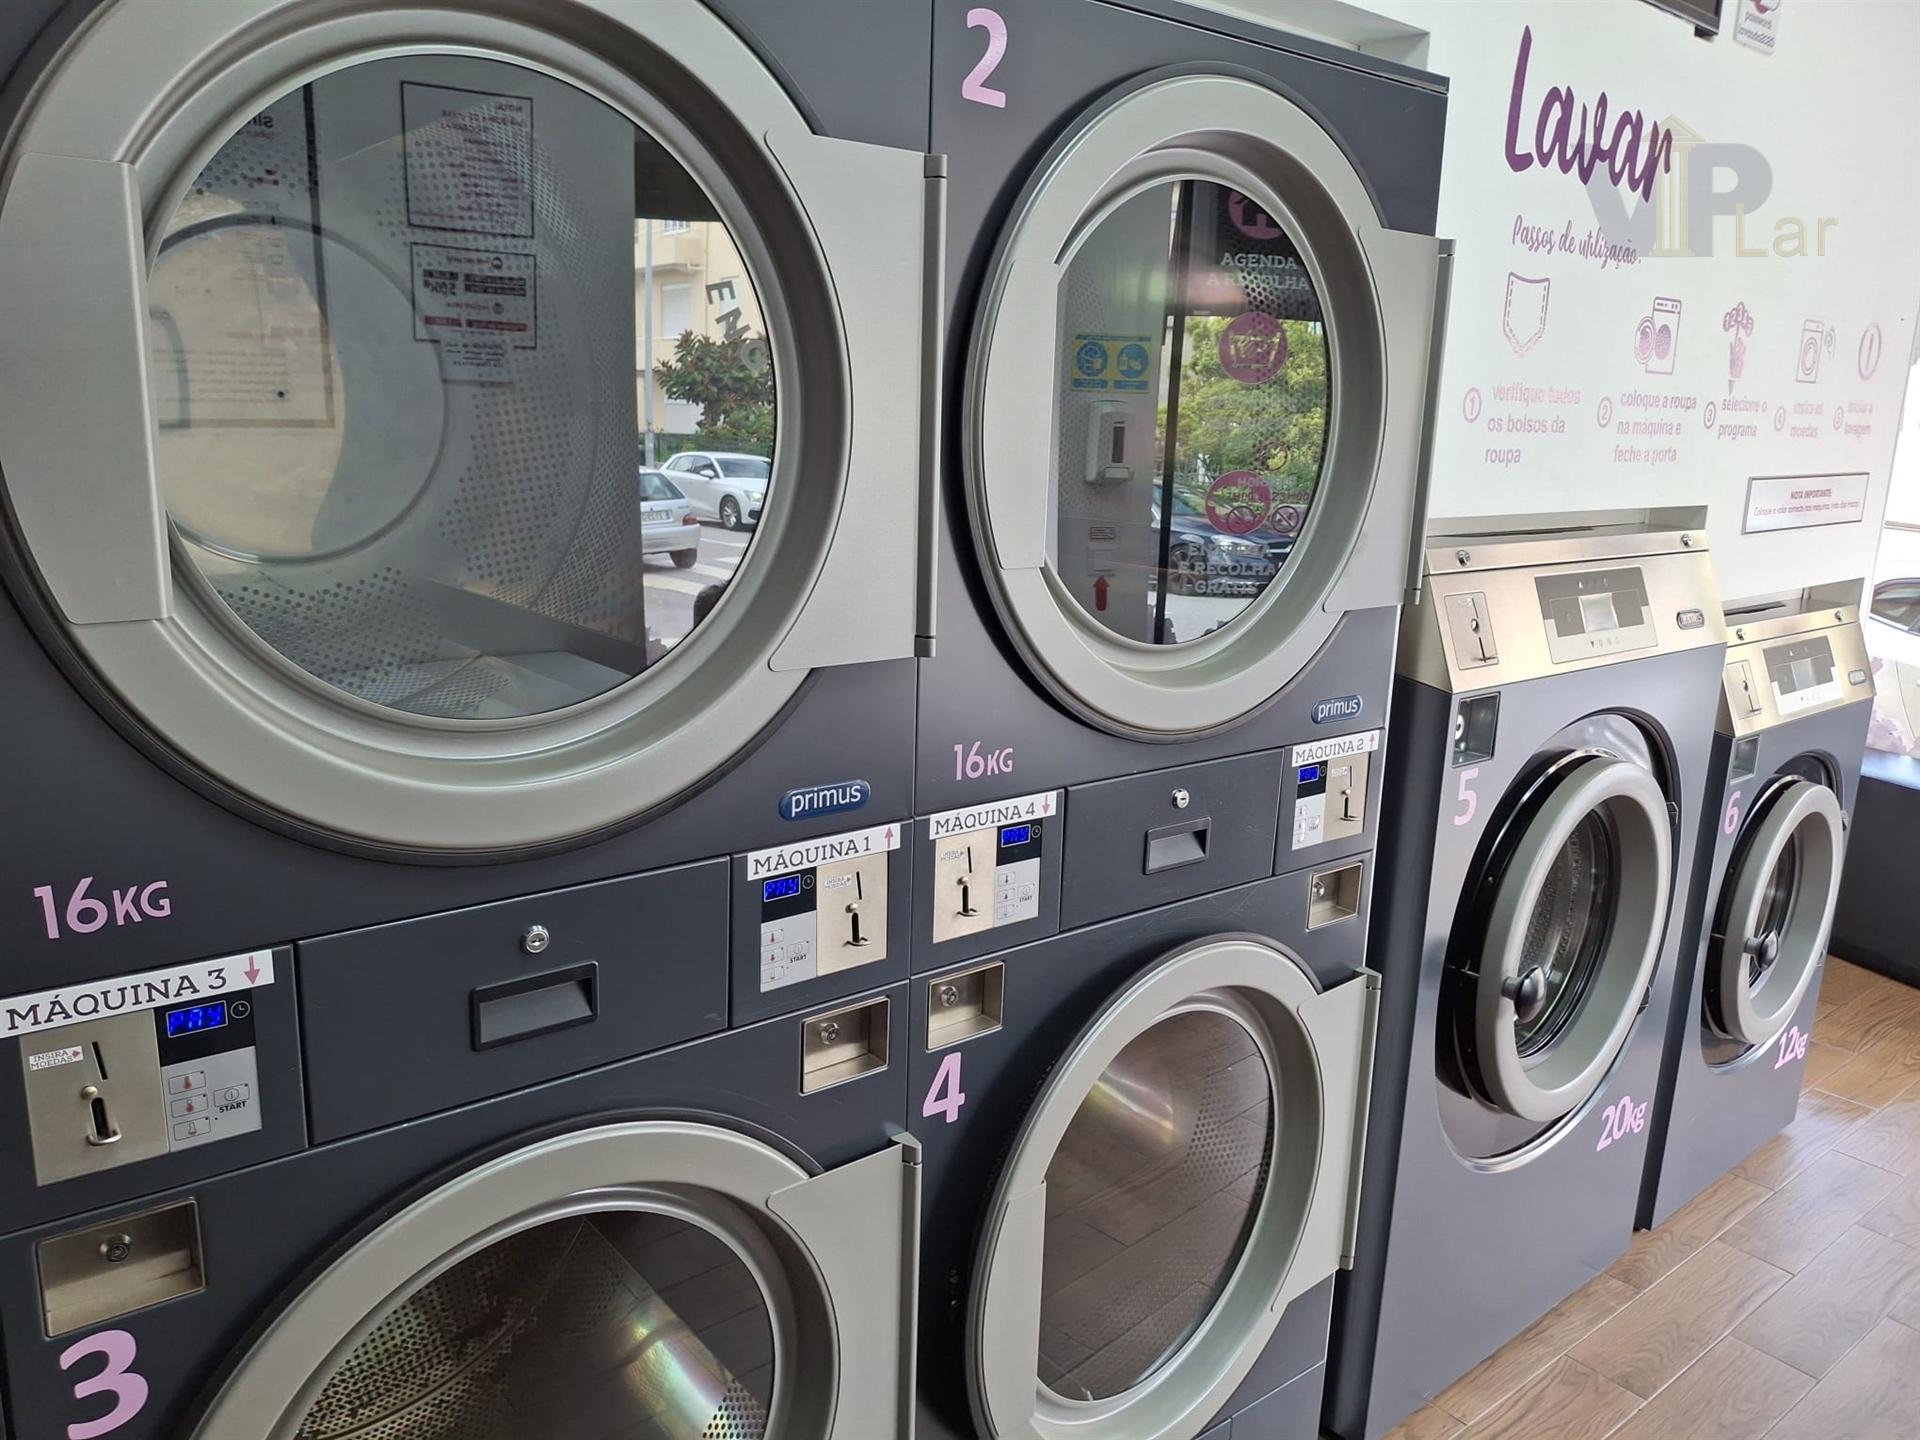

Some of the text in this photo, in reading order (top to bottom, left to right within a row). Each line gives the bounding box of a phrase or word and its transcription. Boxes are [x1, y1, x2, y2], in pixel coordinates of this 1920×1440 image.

[961, 8, 1008, 110] 2
[1504, 24, 1673, 203] Lavar
[1512, 214, 1555, 255] Passos
[1559, 219, 1576, 254] de
[1220, 252, 1297, 270] AGENDA
[1620, 388, 1660, 412] coloque
[1670, 396, 1696, 413] roupa
[1488, 412, 1566, 433] os bolsos da
[1616, 420, 1629, 434] na
[1717, 423, 1758, 441] programa
[1484, 448, 1521, 468] roupa
[1614, 444, 1642, 462] feche
[1317, 699, 1359, 721] primus
[953, 740, 1014, 781] 16KG
[1295, 740, 1365, 764] MÁQUINA 2
[790, 784, 861, 819] primus
[1454, 768, 1480, 827] 5
[1724, 790, 1741, 835] 6
[934, 801, 1036, 835] MÁQUINA 4
[753, 836, 871, 875] MÁQUINA 1
[33, 876, 171, 939] 16KG
[789, 954, 808, 964] START
[7, 968, 227, 1030] MÁQUINA 3
[30, 1055, 75, 1070] MOEDAS
[33, 1049, 69, 1062] INSIRA
[1773, 1024, 1808, 1070] 12kg
[922, 1052, 965, 1124] 4
[219, 1100, 248, 1113] START
[1596, 1094, 1648, 1152] 20kg
[58, 1328, 150, 1440] 3
